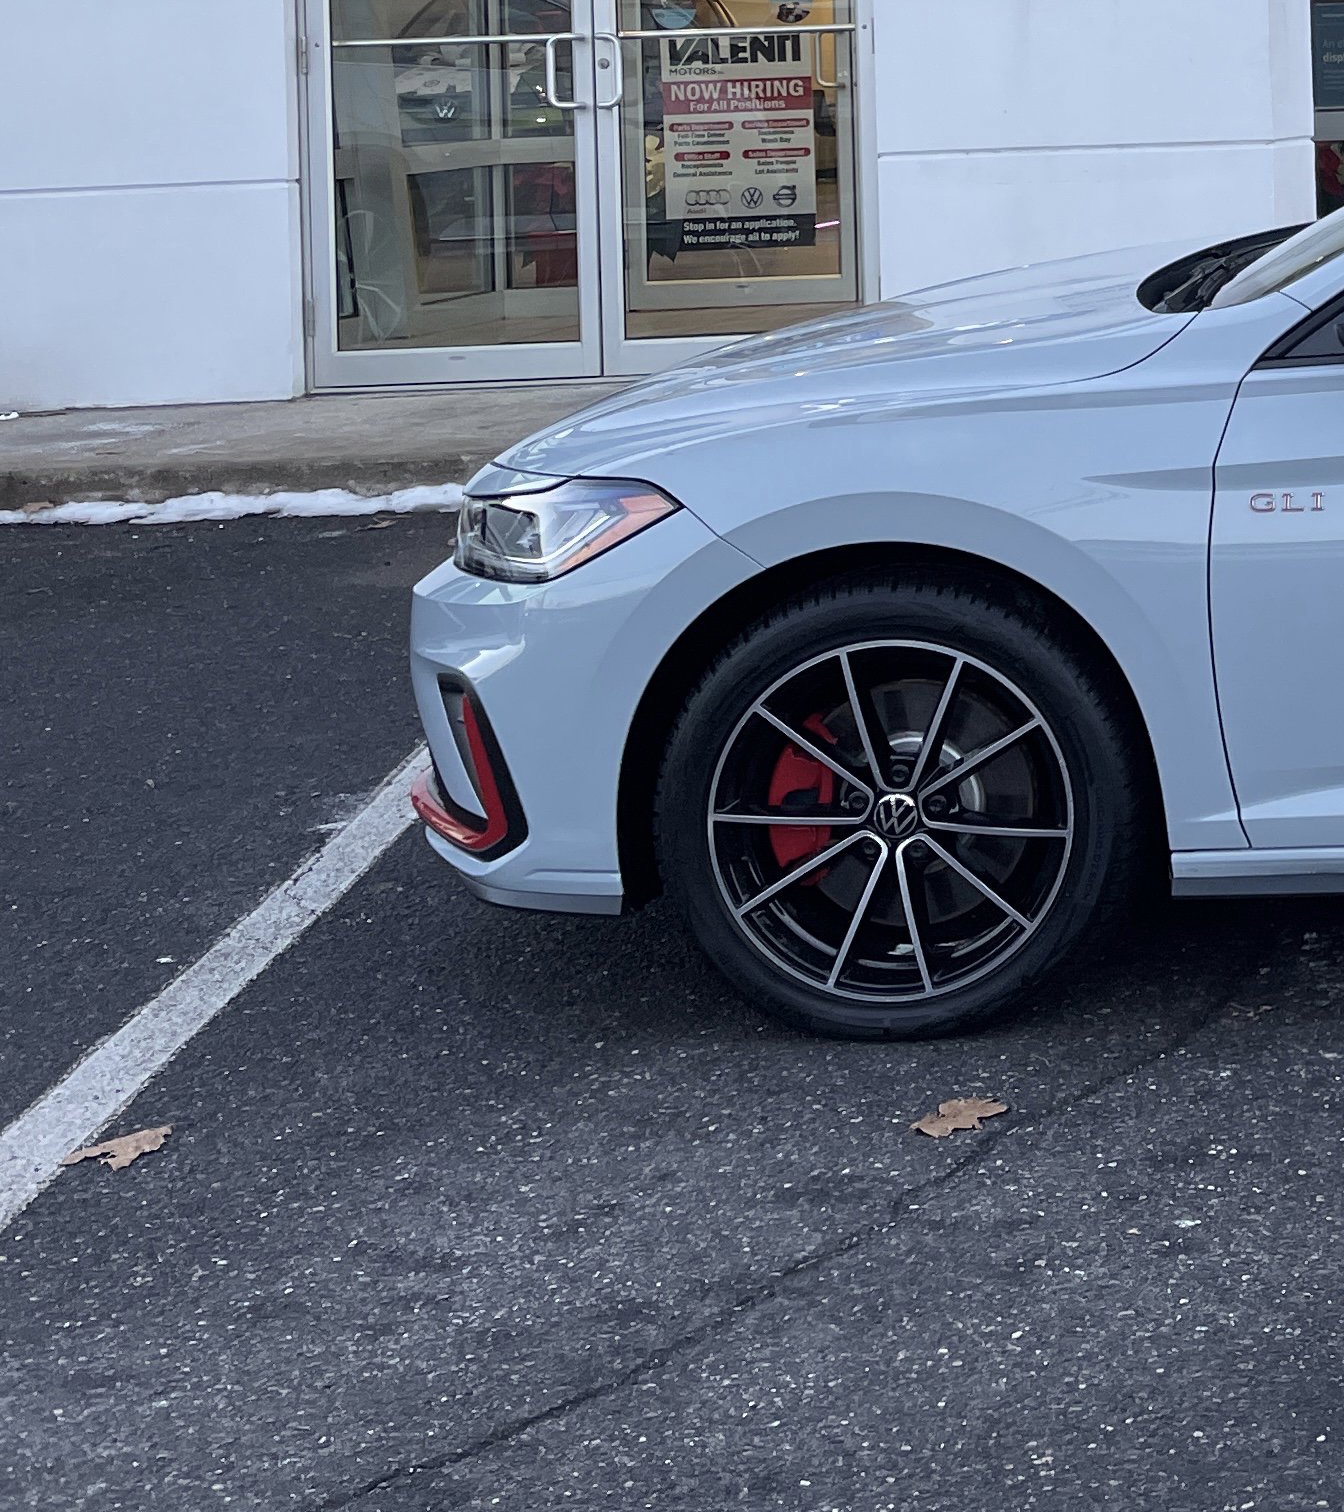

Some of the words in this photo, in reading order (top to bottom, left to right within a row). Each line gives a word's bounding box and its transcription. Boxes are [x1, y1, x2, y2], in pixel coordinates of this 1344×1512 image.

[669, 35, 800, 66] VALENTI
[669, 67, 717, 76] MOTORS
[670, 82, 721, 101] NOW
[727, 80, 804, 99] HIRING
[690, 100, 708, 112] For
[712, 99, 727, 111] All
[730, 98, 786, 111] Positions
[684, 222, 704, 232] Stop
[706, 220, 715, 230] in
[716, 220, 729, 230] for
[731, 221, 742, 229] an
[744, 218, 797, 230] application.
[684, 234, 698, 244] We
[748, 232, 760, 241] all
[761, 232, 770, 241] to
[772, 230, 800, 243] apply!
[1250, 492, 1324, 513] GLI
